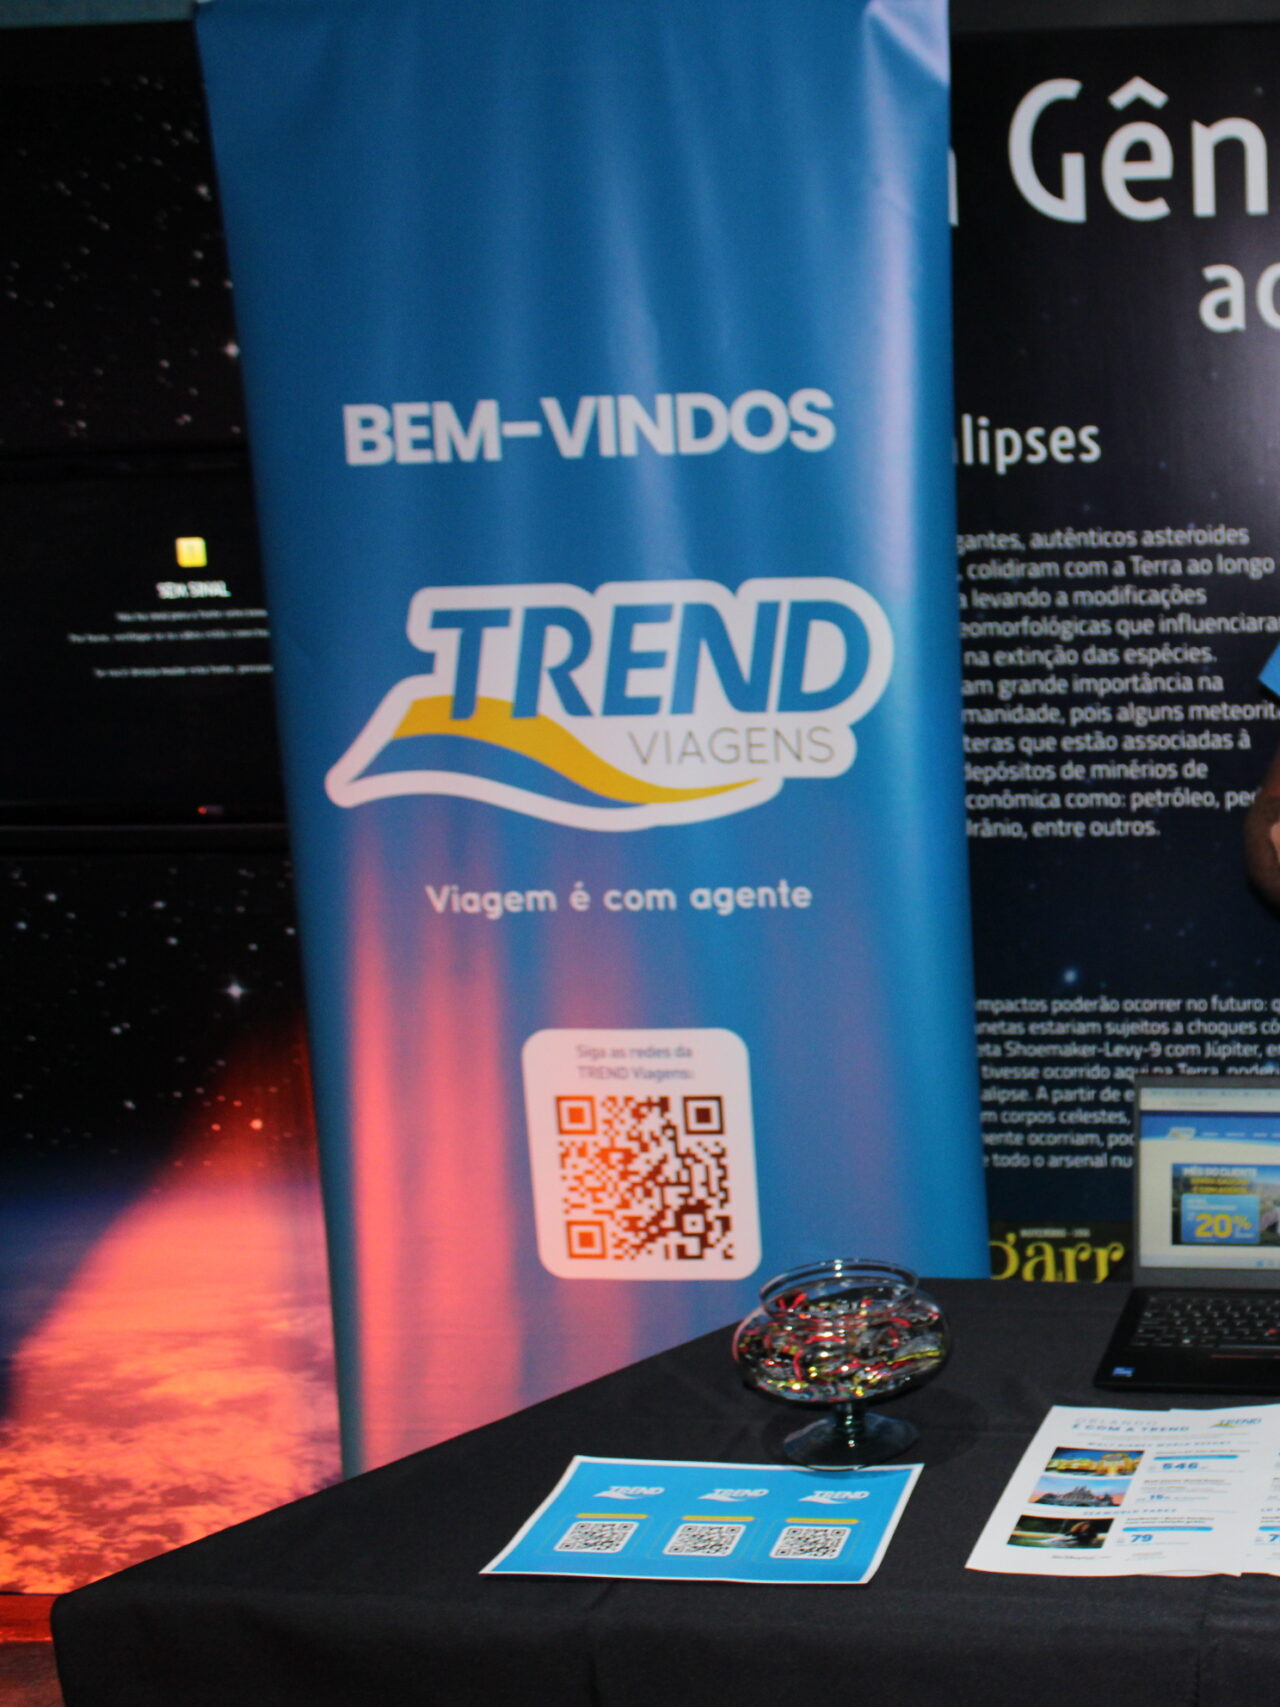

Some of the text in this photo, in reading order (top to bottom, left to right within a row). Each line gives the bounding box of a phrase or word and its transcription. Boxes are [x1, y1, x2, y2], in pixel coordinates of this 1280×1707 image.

[342, 388, 837, 467] BEM-VINDOS
[957, 412, 1101, 475] lipses
[1030, 526, 1138, 549] autênticos
[1141, 524, 1249, 547] asteroides
[966, 553, 1275, 580] colidiram com a Terra ao longo
[971, 587, 1051, 609] levando
[1055, 591, 1069, 607] a
[1072, 583, 1207, 610] modificações
[1115, 618, 1154, 640] que
[429, 599, 871, 721] TREND
[963, 642, 1217, 670] na extinção das espécies.
[997, 674, 1068, 700] grande
[1072, 671, 1194, 697] importância
[1197, 675, 1224, 692] na
[1070, 703, 1112, 727] pois
[1116, 701, 1185, 727] alguns
[627, 725, 836, 765] VIAGENS
[1018, 735, 1057, 757] que
[1060, 730, 1118, 751] estão
[1122, 729, 1234, 750] associadas
[1238, 728, 1251, 749] à
[1060, 760, 1086, 780] de
[1090, 758, 1178, 779] minérios
[1182, 758, 1208, 779] de
[964, 788, 1061, 810] conômica
[1064, 792, 1126, 808] como:
[1130, 787, 1220, 813] petróleo,
[1031, 818, 1086, 838] entre
[1089, 817, 1161, 838] outros.
[426, 879, 812, 920] Viagem é com agente
[1051, 995, 1120, 1015] poderão
[1122, 998, 1183, 1012] ocorrer
[1185, 998, 1208, 1012] no
[1028, 1019, 1102, 1035] estariam
[1104, 1018, 1170, 1038] sujeitos
[1172, 1021, 1184, 1035] a
[1186, 1018, 1257, 1038] choques
[1164, 1044, 1201, 1058] com
[1036, 1085, 1049, 1101] A
[1051, 1086, 1096, 1104] partir
[1100, 1086, 1121, 1101] de
[1000, 1111, 1056, 1127] corpos
[1058, 1108, 1131, 1126] celestes,
[992, 1152, 1031, 1168] todo
[1032, 1155, 1045, 1168] o
[1047, 1153, 1108, 1168] arsenal
[1131, 1534, 1153, 1543] 79
